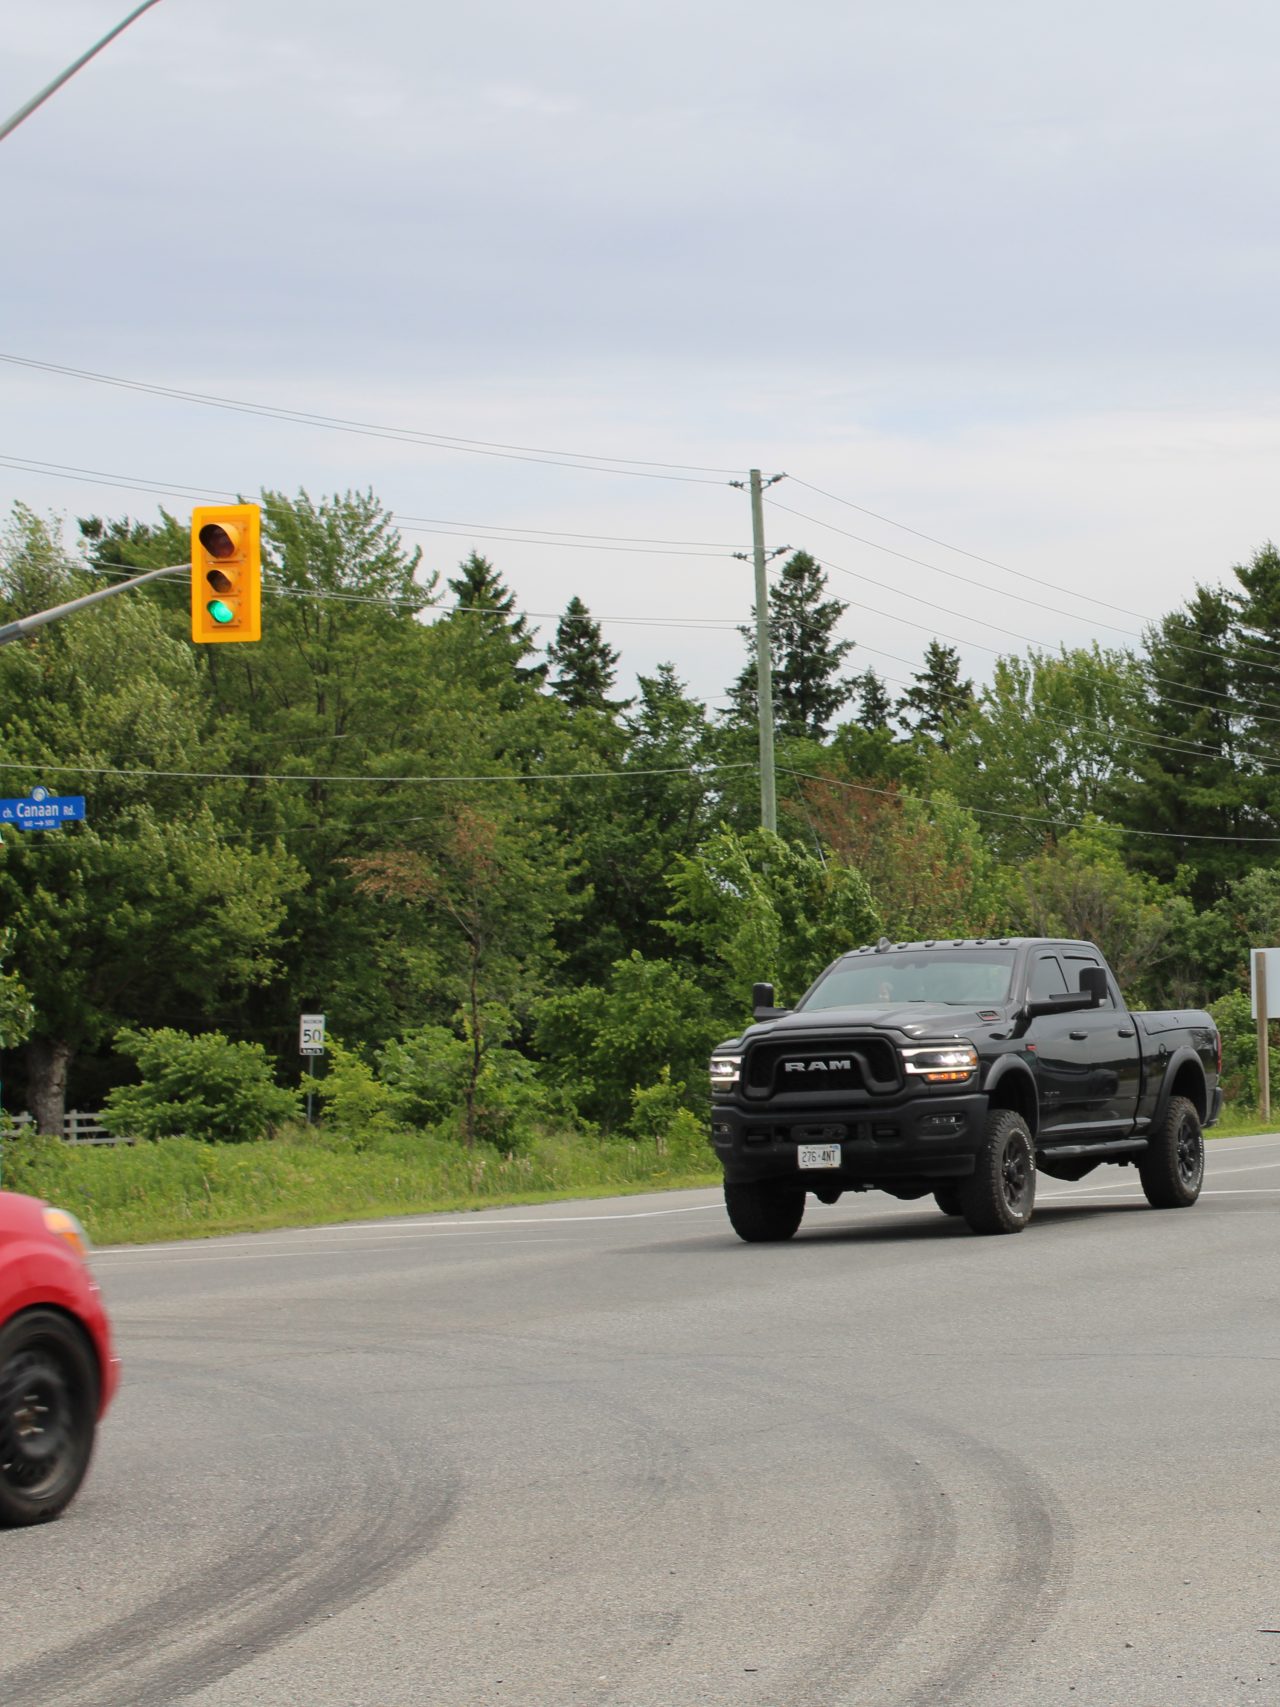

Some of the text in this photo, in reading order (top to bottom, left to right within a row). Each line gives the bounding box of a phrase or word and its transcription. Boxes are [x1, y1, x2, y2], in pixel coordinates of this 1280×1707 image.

[16, 802, 59, 818] Canaan
[63, 805, 76, 816] Rd.
[303, 1029, 322, 1043] 50
[784, 1060, 851, 1072] RAM
